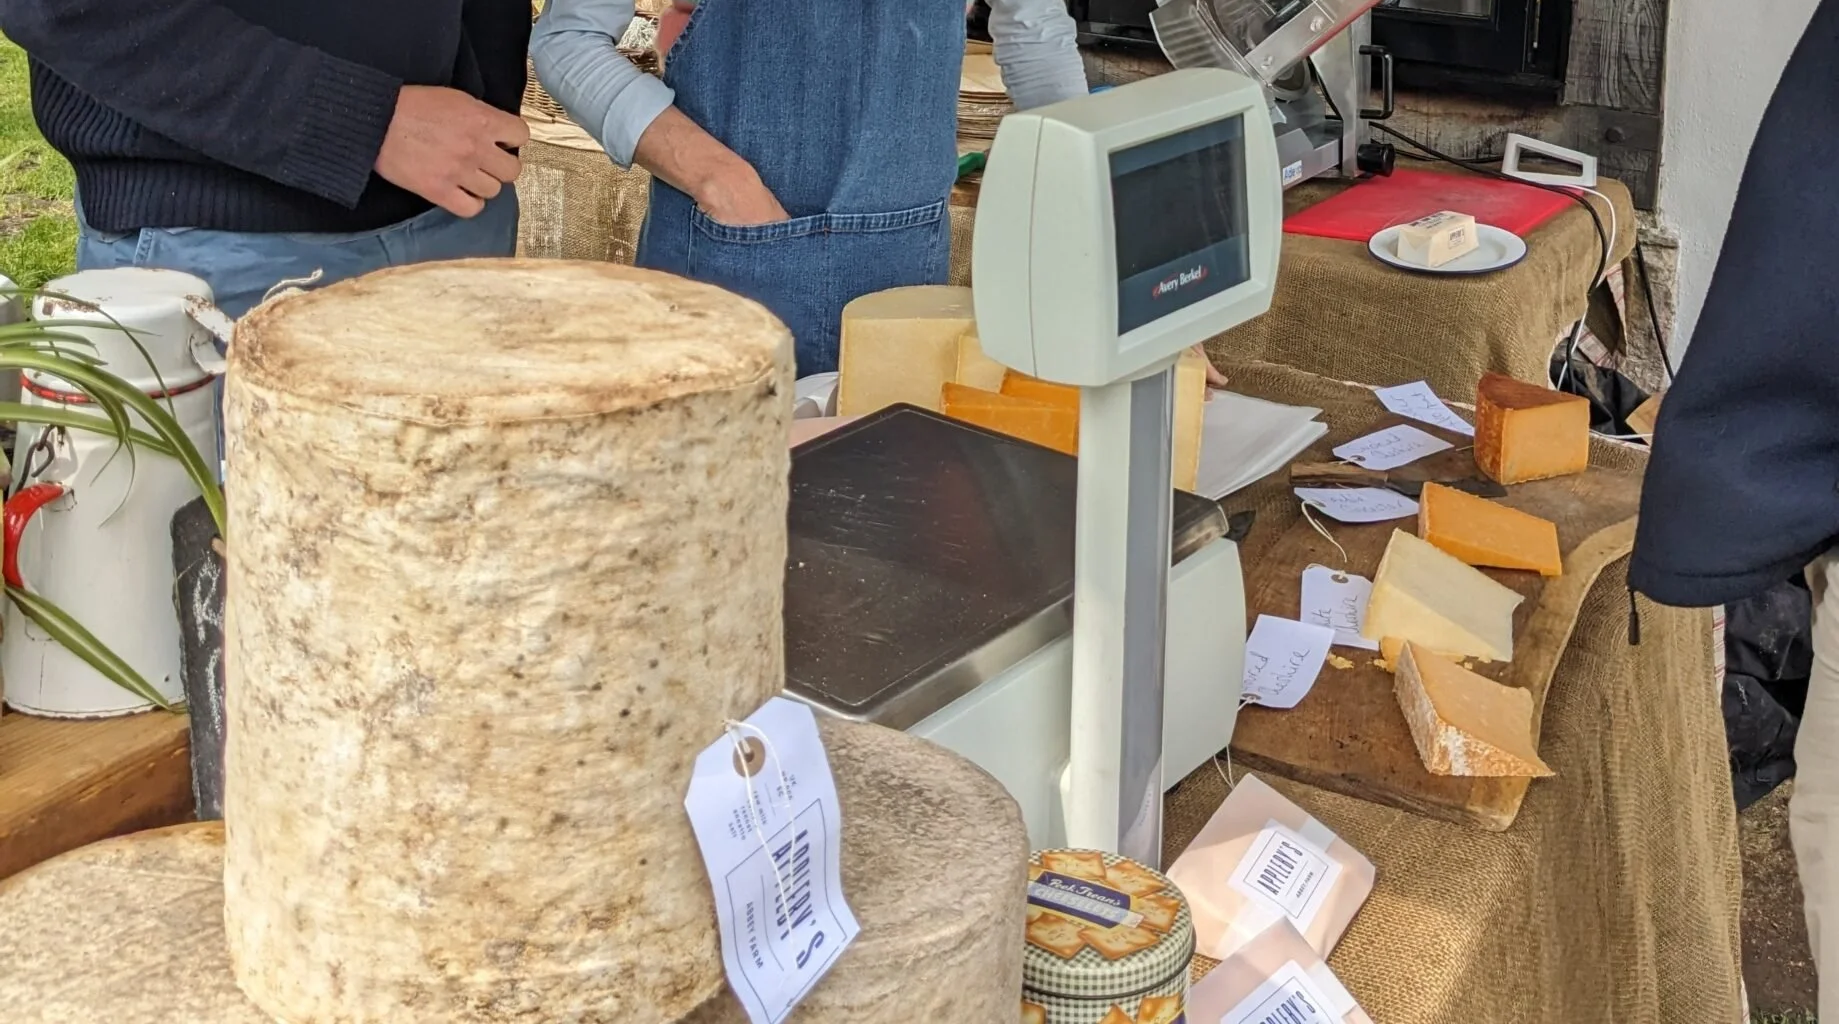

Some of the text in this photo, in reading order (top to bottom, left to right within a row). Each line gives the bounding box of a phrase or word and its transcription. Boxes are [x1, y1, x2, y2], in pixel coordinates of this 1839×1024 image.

[1158, 264, 1201, 294] Avery Berkel
[1257, 841, 1303, 896] APPLEBY'S
[771, 828, 825, 970] APPLEBY'S
[748, 935, 764, 969] FARM
